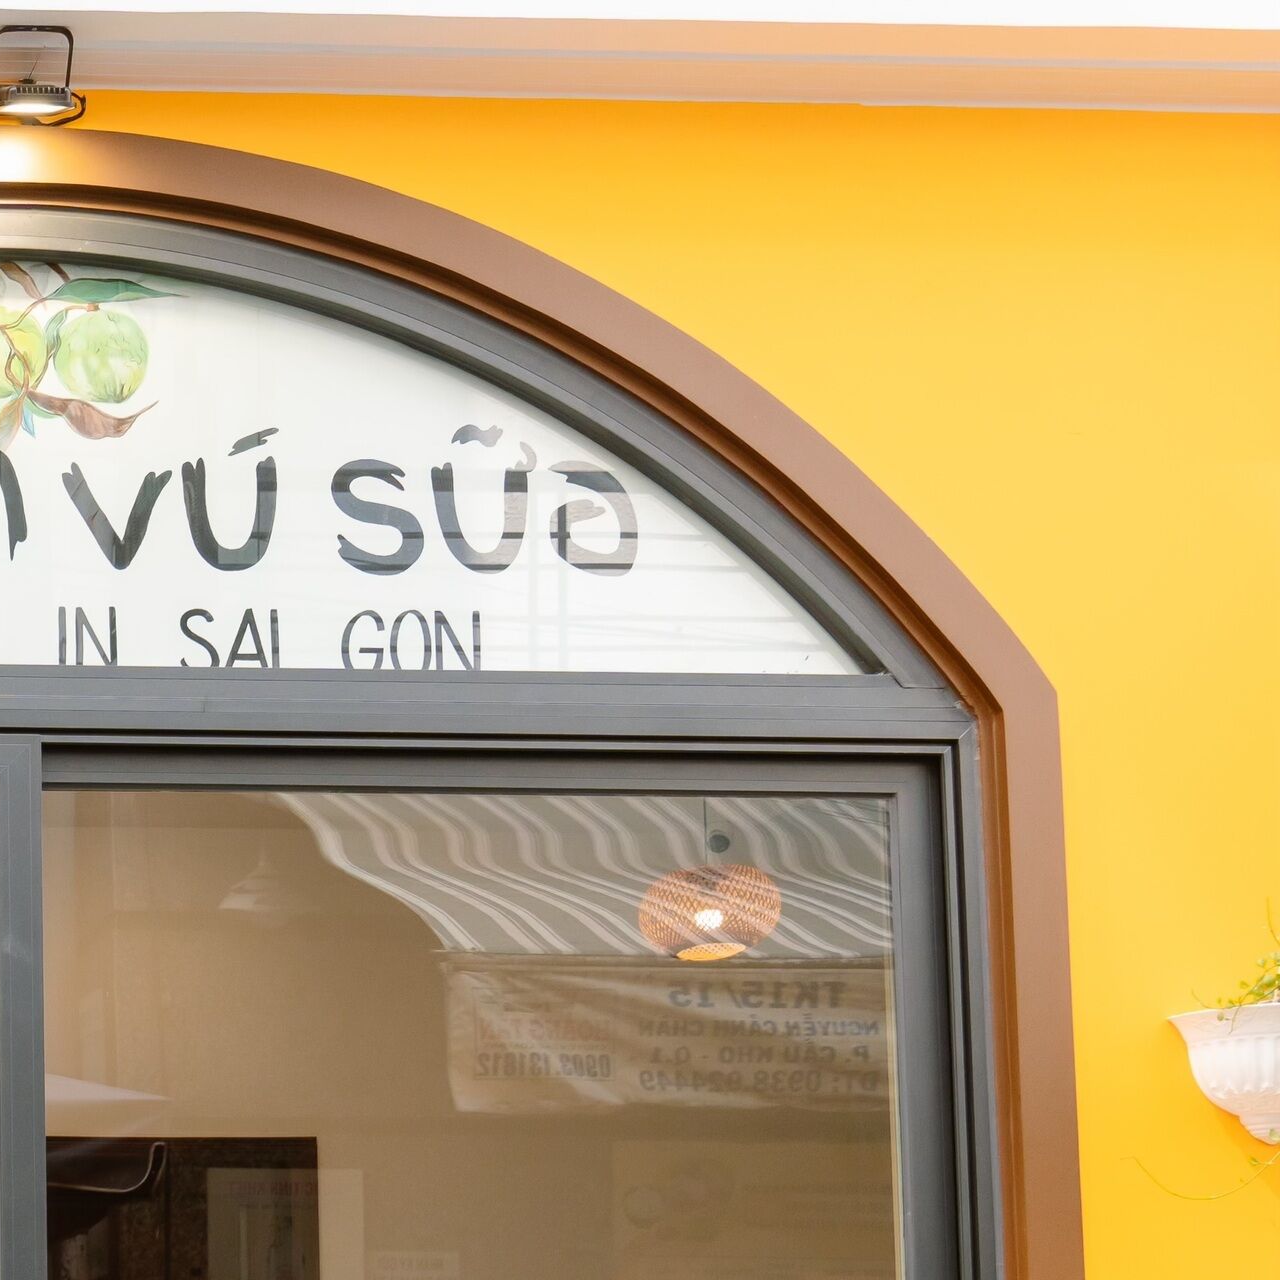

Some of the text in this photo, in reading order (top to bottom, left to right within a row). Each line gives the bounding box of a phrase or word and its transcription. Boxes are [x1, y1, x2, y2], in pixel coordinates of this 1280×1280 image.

[62, 426, 280, 572] vú
[57, 606, 119, 667] IN
[180, 608, 280, 669] SAI
[342, 609, 481, 671] GON
